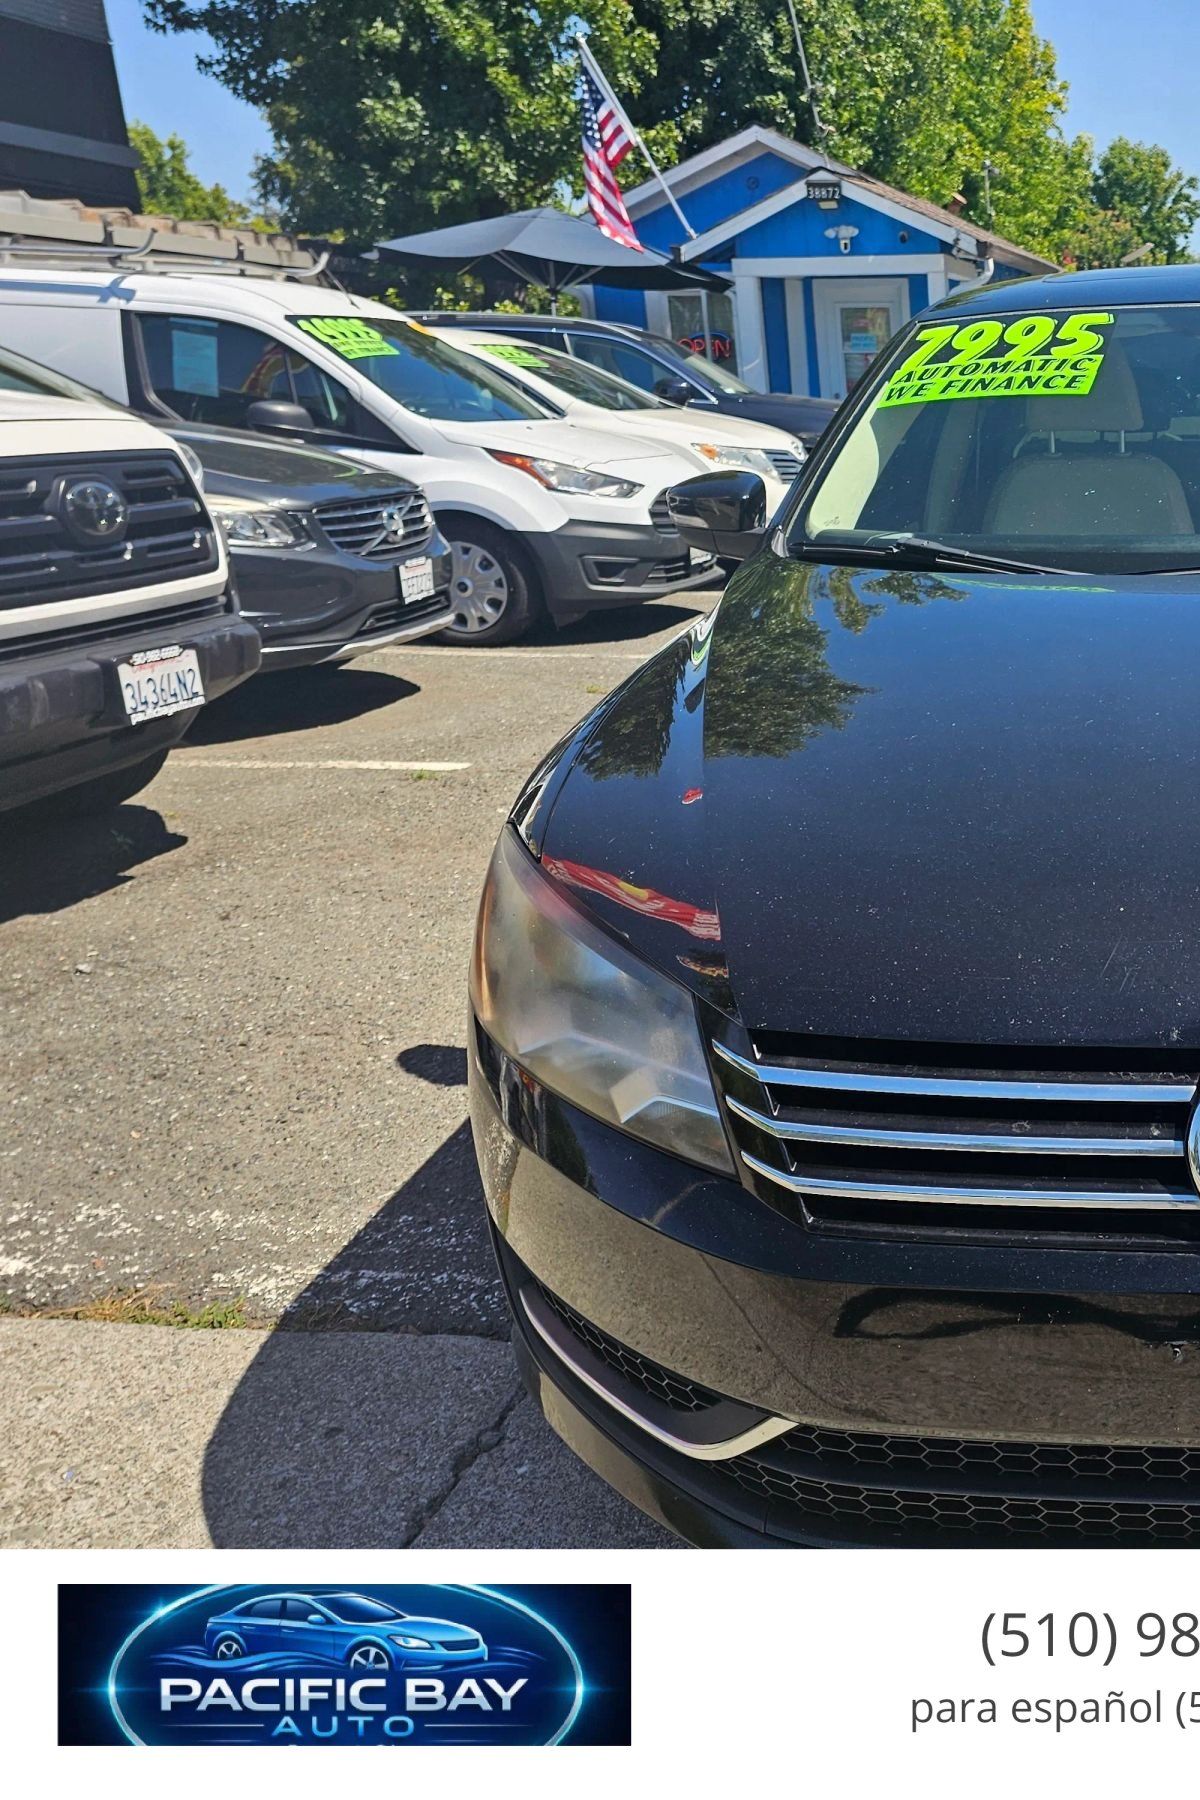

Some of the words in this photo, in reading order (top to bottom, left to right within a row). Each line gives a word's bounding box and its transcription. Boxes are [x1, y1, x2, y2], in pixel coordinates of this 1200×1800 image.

[678, 338, 731, 358] OPN
[901, 312, 1114, 372] 7995
[893, 357, 1097, 385] AUTOMATIC
[885, 381, 934, 401] WE
[939, 373, 1087, 395] FINANCE
